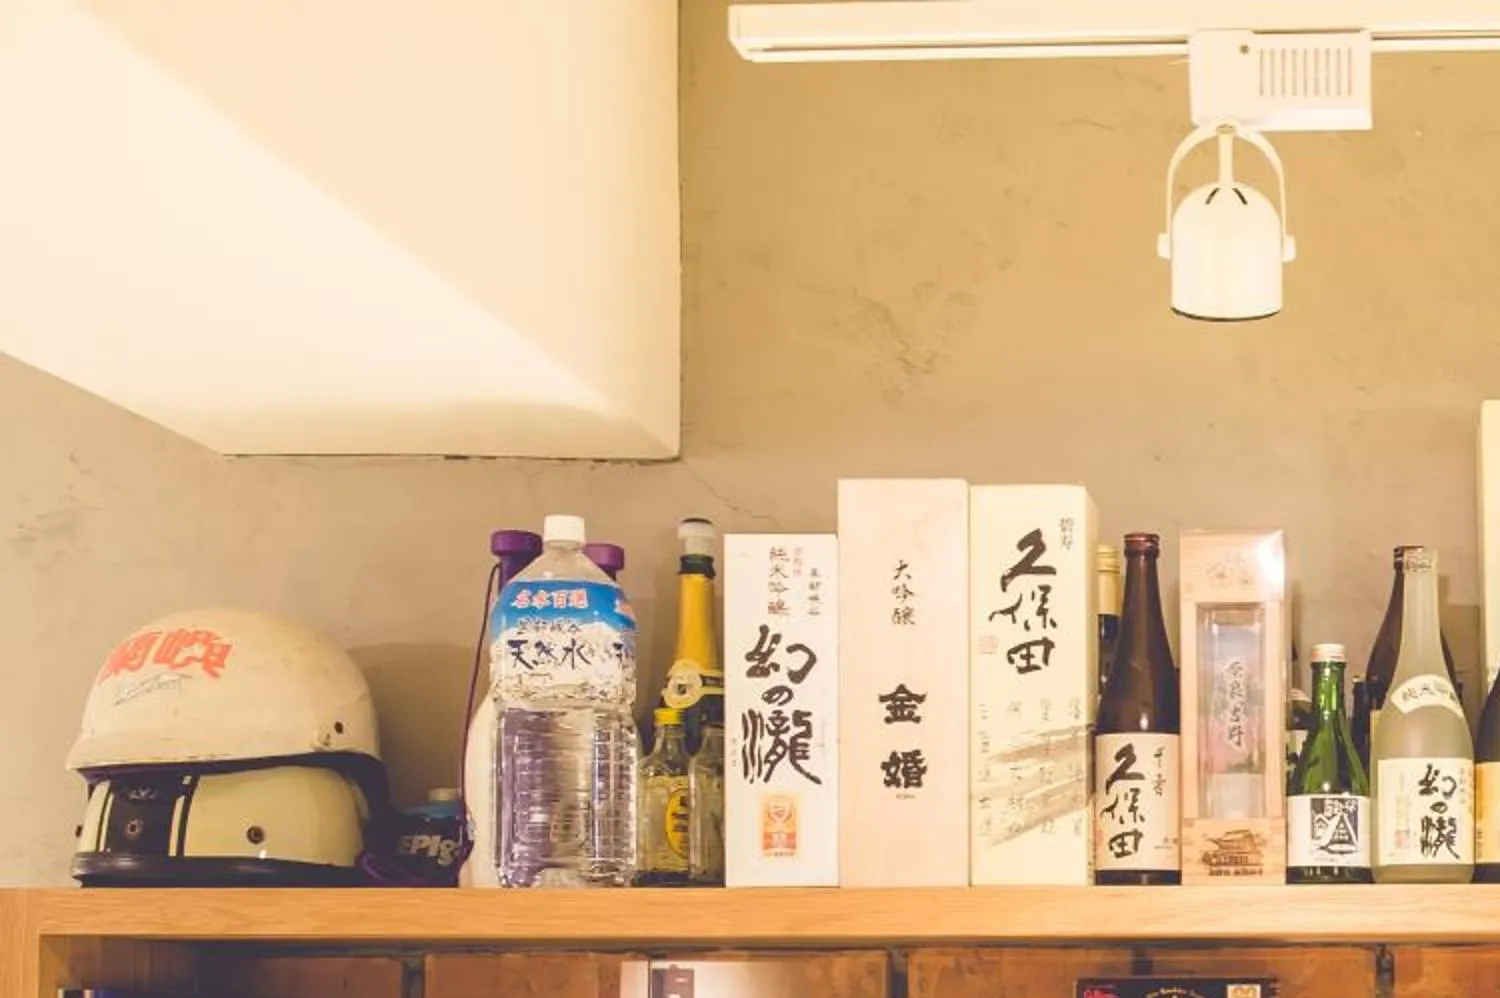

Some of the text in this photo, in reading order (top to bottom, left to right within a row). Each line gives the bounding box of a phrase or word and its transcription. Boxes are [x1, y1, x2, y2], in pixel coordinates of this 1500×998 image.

[507, 638, 593, 671] 天然水
[988, 528, 1057, 675] 久保田
[742, 624, 823, 785] 幻の瀧
[878, 684, 928, 790] 金婚
[1100, 743, 1146, 859] 久保田
[1418, 763, 1461, 860] 幻の瀧
